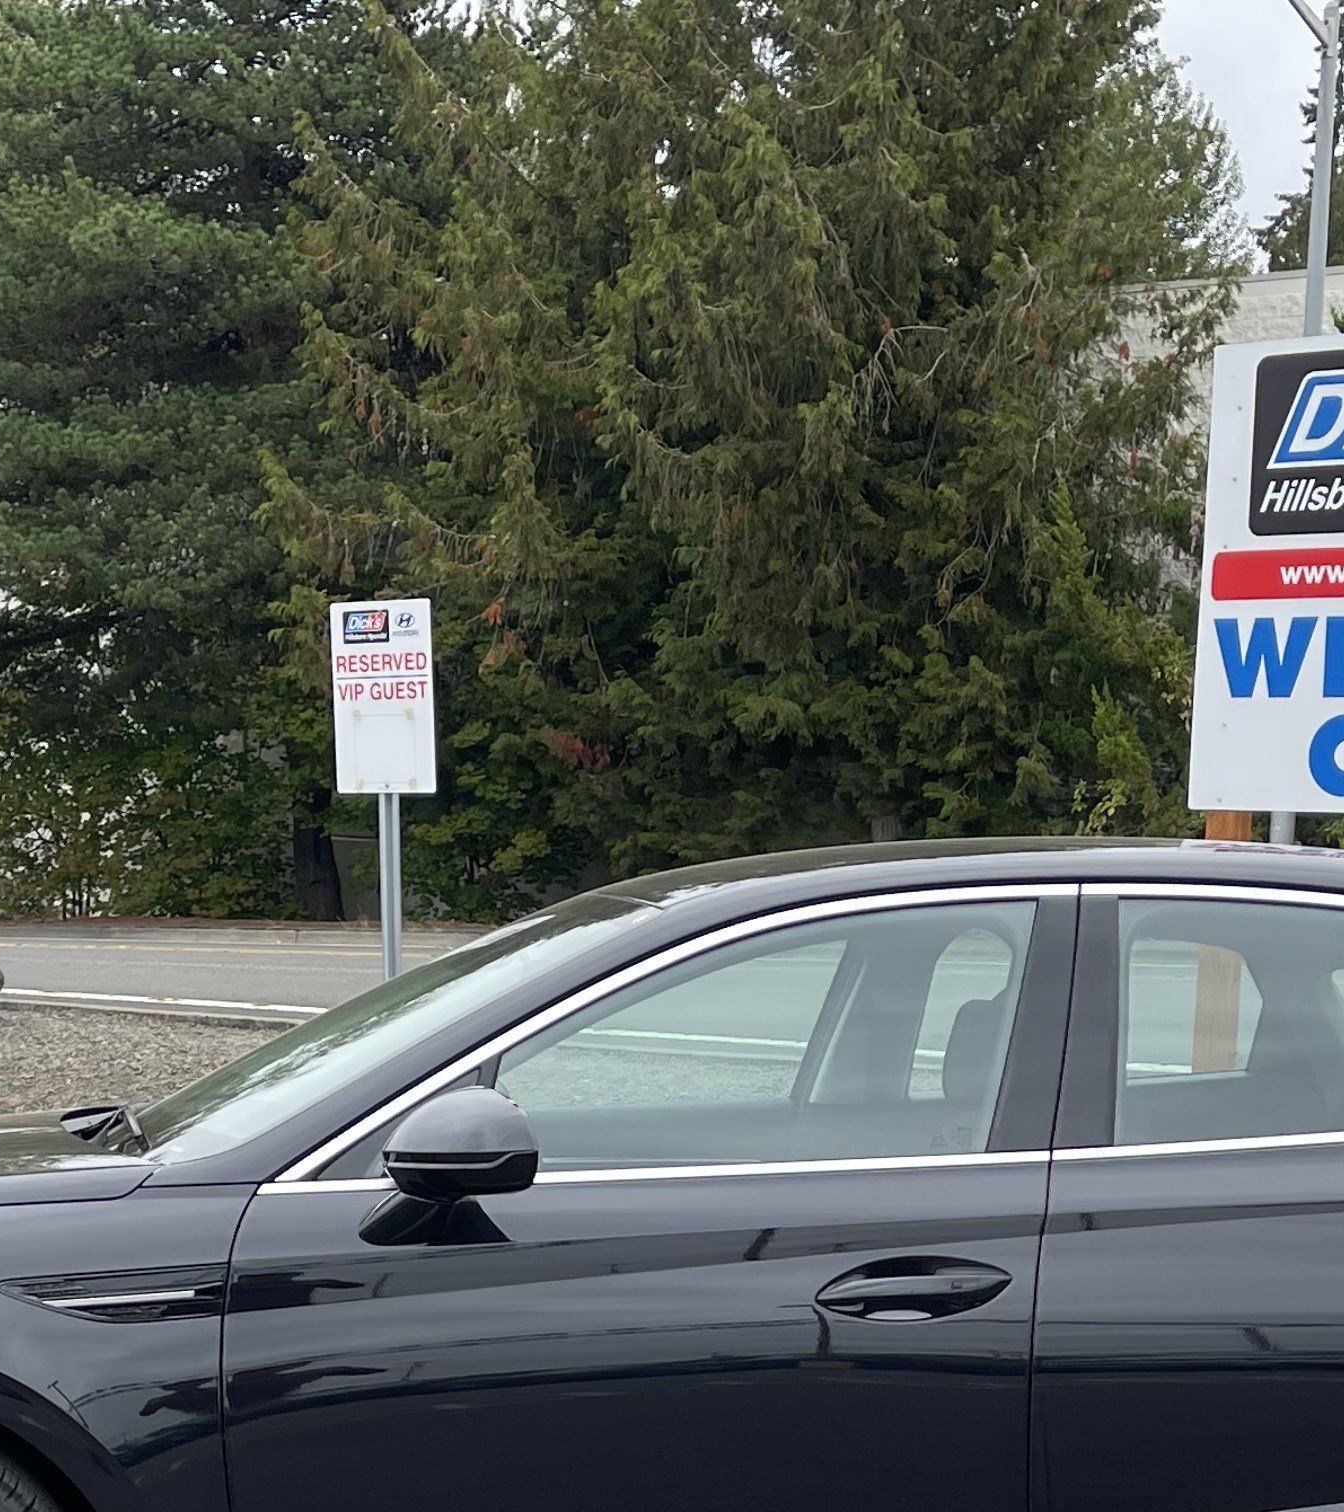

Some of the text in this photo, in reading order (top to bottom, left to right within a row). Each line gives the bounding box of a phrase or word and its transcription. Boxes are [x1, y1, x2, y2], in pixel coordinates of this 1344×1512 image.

[336, 652, 427, 673] RESERVED
[338, 681, 428, 701] VIP GUEST
